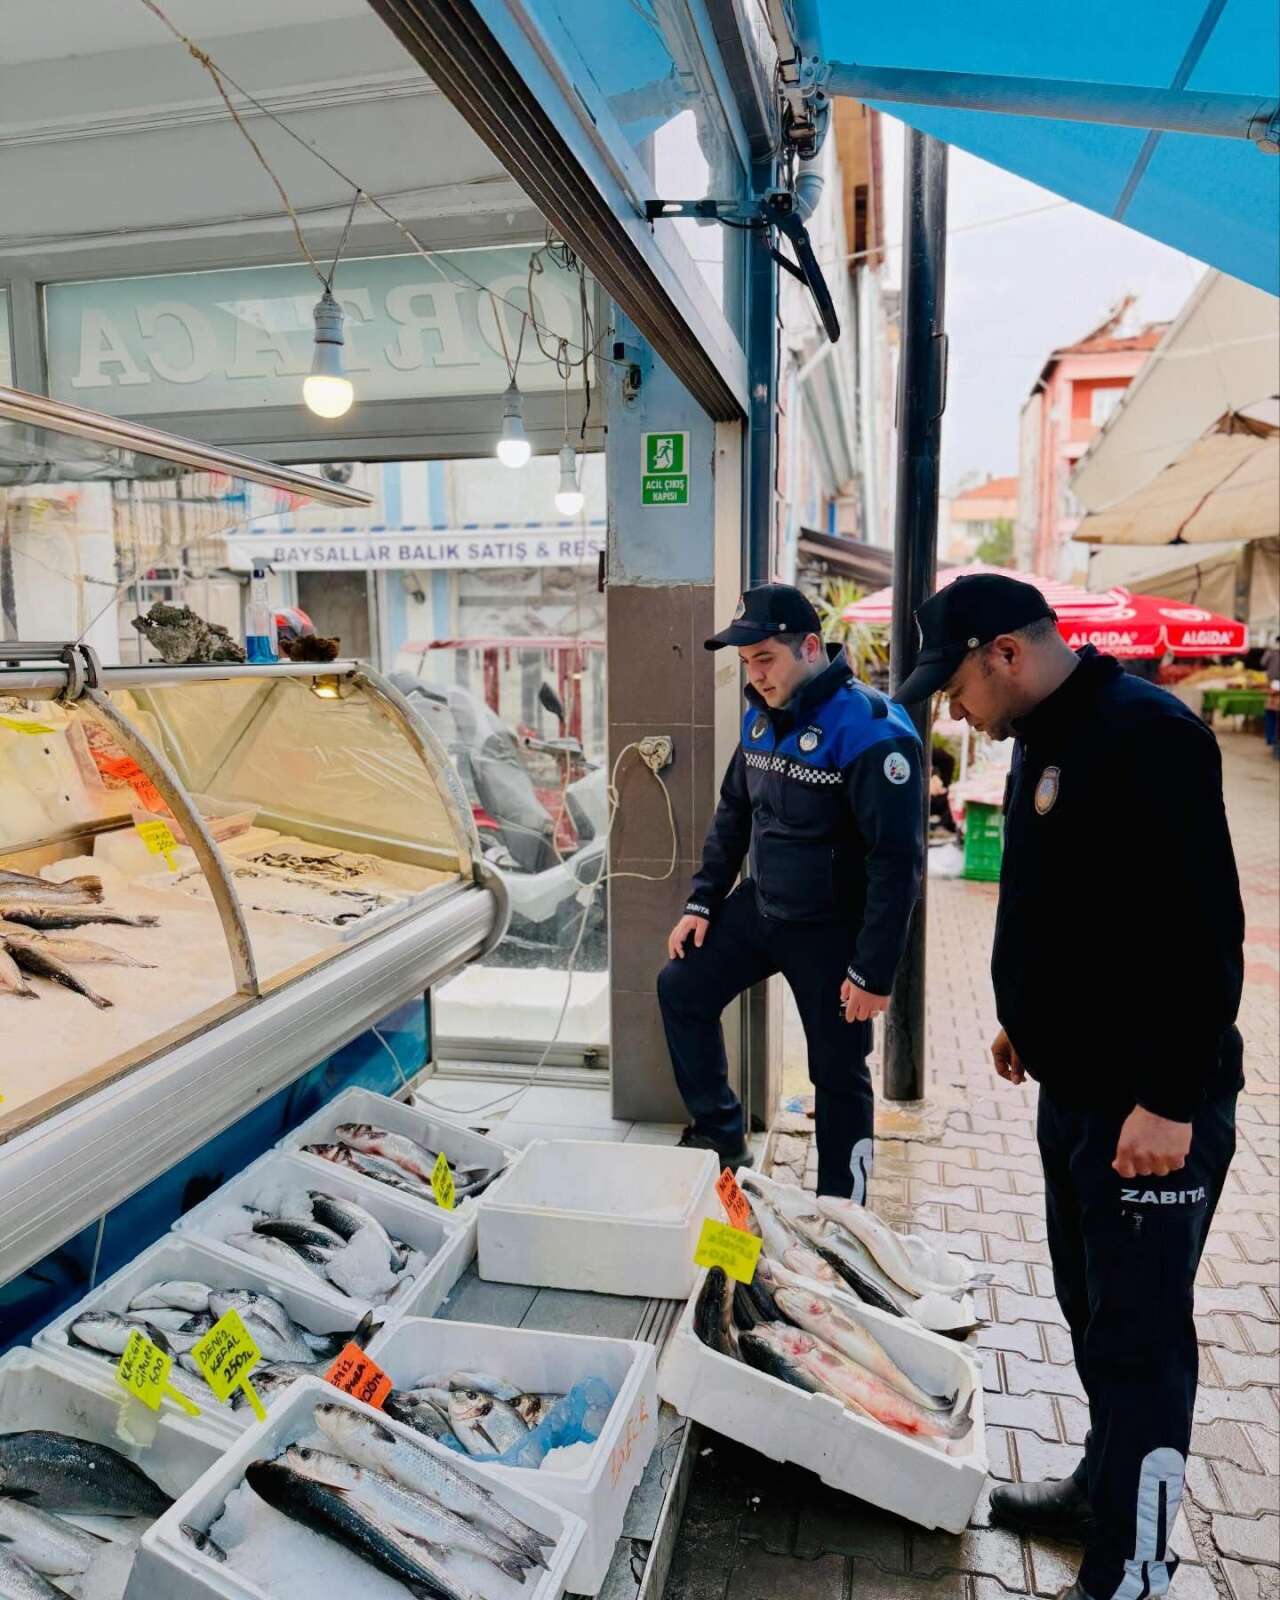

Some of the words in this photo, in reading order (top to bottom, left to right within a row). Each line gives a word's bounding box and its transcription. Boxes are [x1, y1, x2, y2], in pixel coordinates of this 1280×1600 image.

[274, 545, 391, 562] BAYSALLAR
[399, 544, 459, 560] BALIK
[467, 542, 527, 562] SATIŞ
[537, 541, 549, 557] &
[1181, 631, 1231, 645] ALGIDA
[1120, 1186, 1205, 1204] ZABITA
